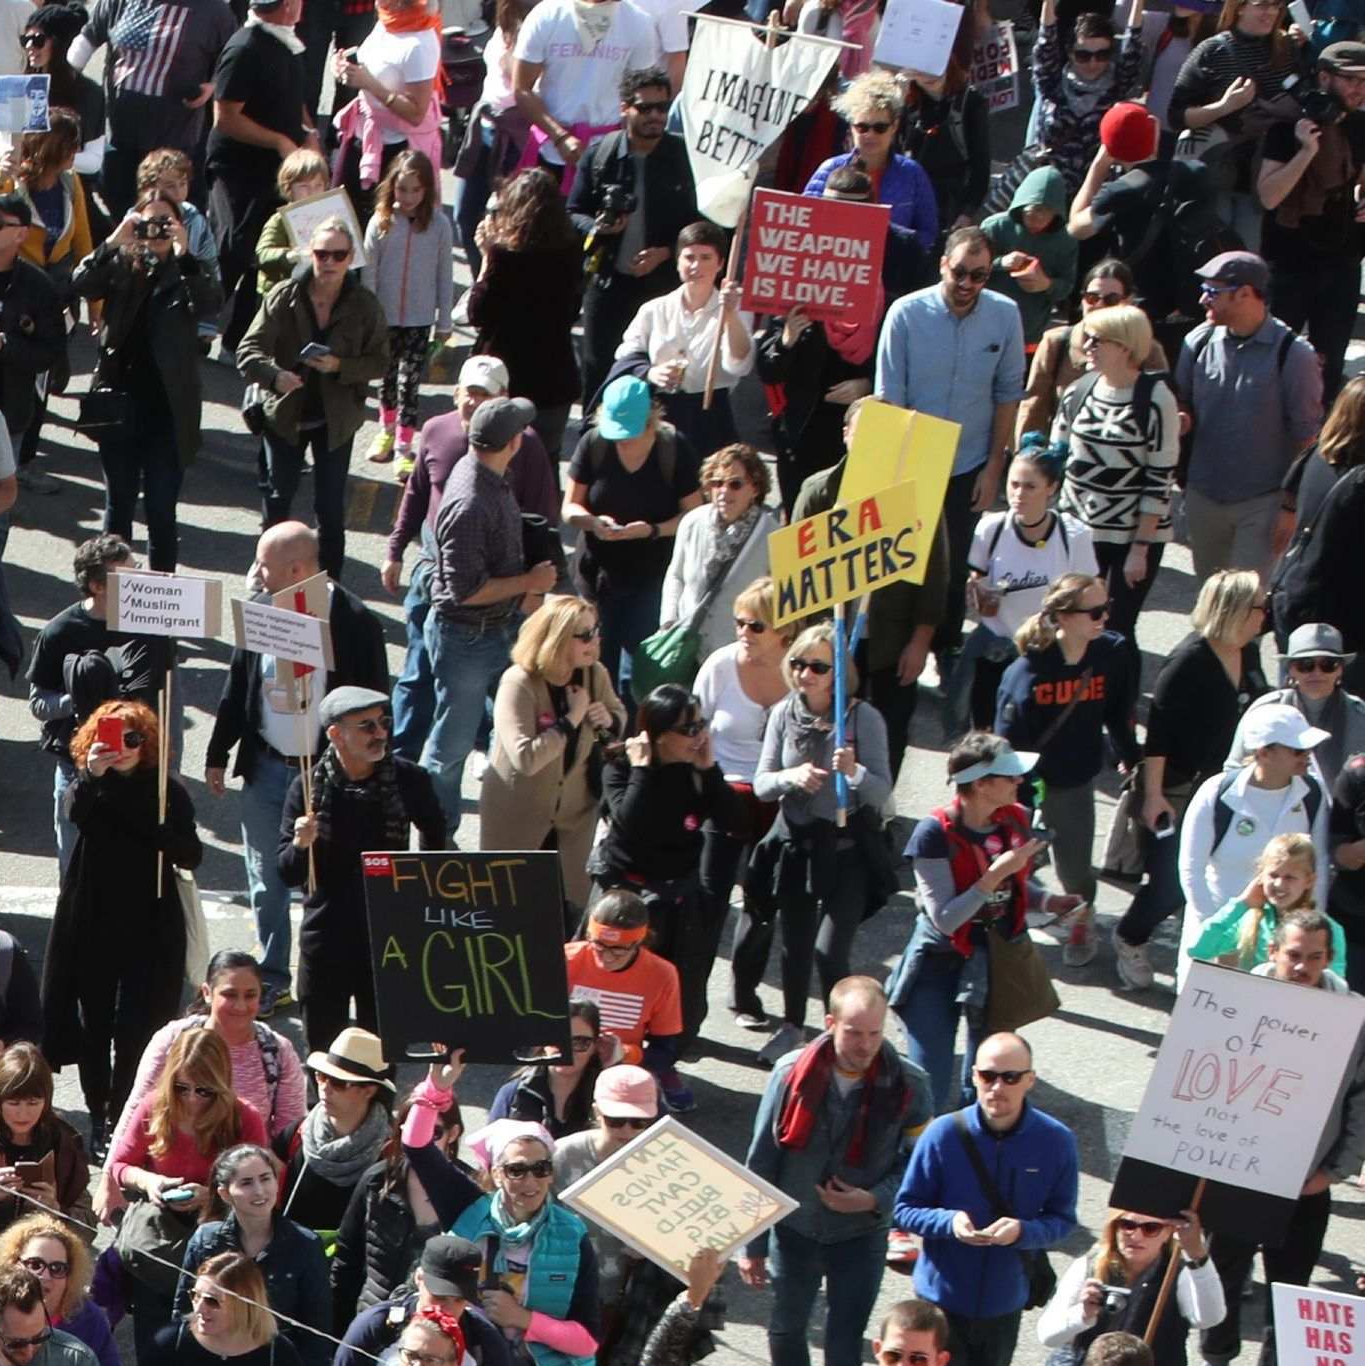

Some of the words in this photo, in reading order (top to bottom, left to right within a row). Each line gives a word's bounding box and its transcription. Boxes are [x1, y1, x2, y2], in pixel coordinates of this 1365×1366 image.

[700, 70, 809, 130] IMAGINE
[763, 200, 813, 228] THE
[758, 230, 870, 259] WEAPON
[797, 497, 882, 559] ERA
[130, 582, 182, 597] Woman
[1000, 573, 1049, 595] Ladies
[130, 614, 200, 628] Immigrant
[364, 857, 389, 866] SOS
[391, 858, 527, 906] FIGHT
[424, 906, 493, 929] LIKE
[381, 936, 408, 969] A
[422, 930, 567, 1019] GIRL
[1171, 1048, 1304, 1116] LOVE
[1172, 1140, 1262, 1175] POWER
[1297, 1297, 1356, 1328] HATE
[1306, 1326, 1354, 1356] HAS
